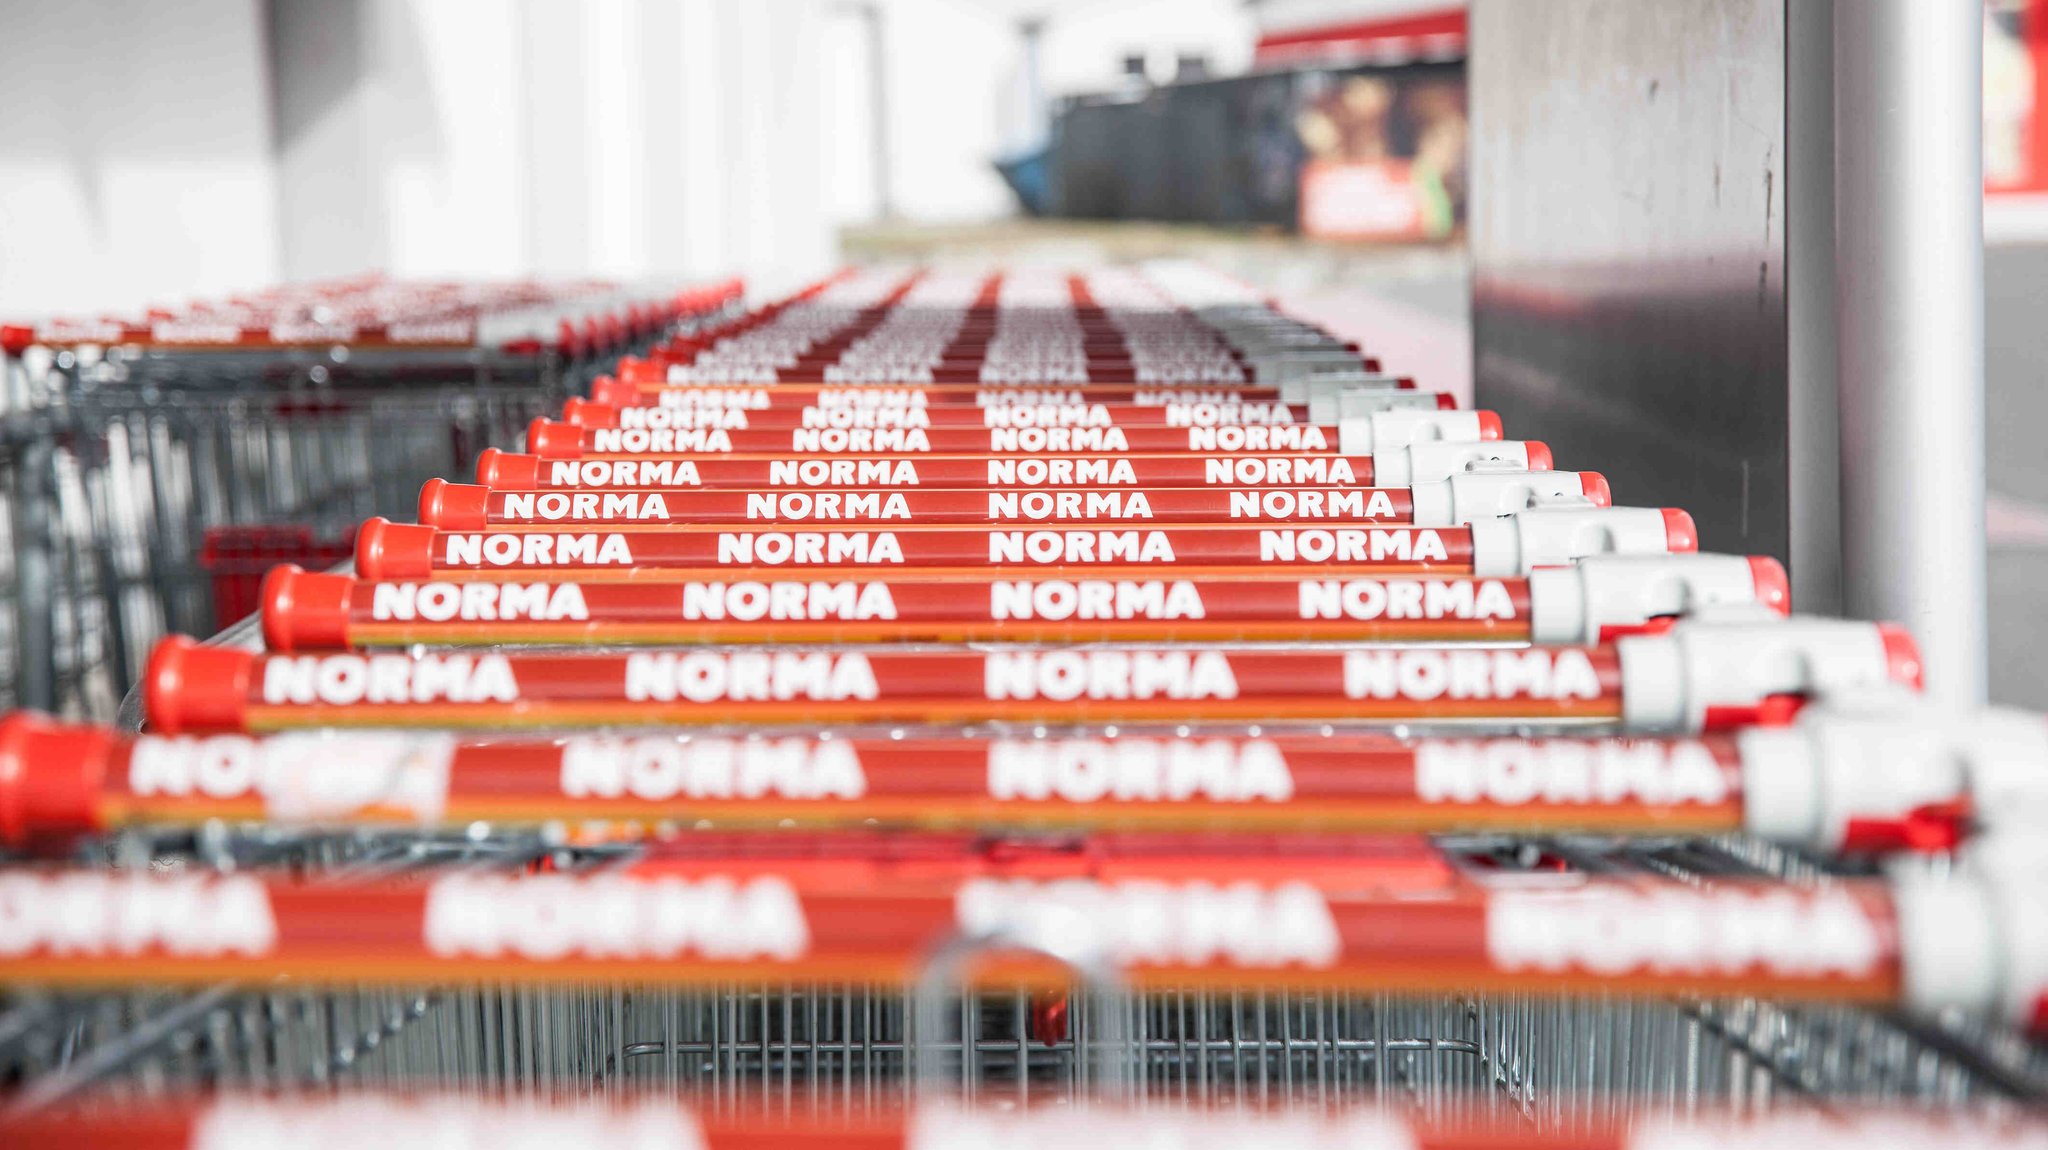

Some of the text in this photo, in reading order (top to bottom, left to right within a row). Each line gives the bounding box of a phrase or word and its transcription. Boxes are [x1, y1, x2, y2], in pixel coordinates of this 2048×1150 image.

[621, 402, 1293, 429] NORMA NORMA NORMA NORMA
[595, 426, 1327, 452] NORMA NORMA NORMA NORMA
[551, 458, 1356, 486] NORMA NORMA NORMA NORMA
[503, 491, 1396, 519] NORMA NORMA NORMA NORMA
[446, 530, 1448, 565] NORMA NORMA NORMA NORMA
[373, 579, 1516, 621] NORMA NORMA NORMA NORMA
[263, 649, 1602, 704] NORMA NORMA NORMA NORMA
[560, 735, 1728, 803] NORMA NORMA NORMA
